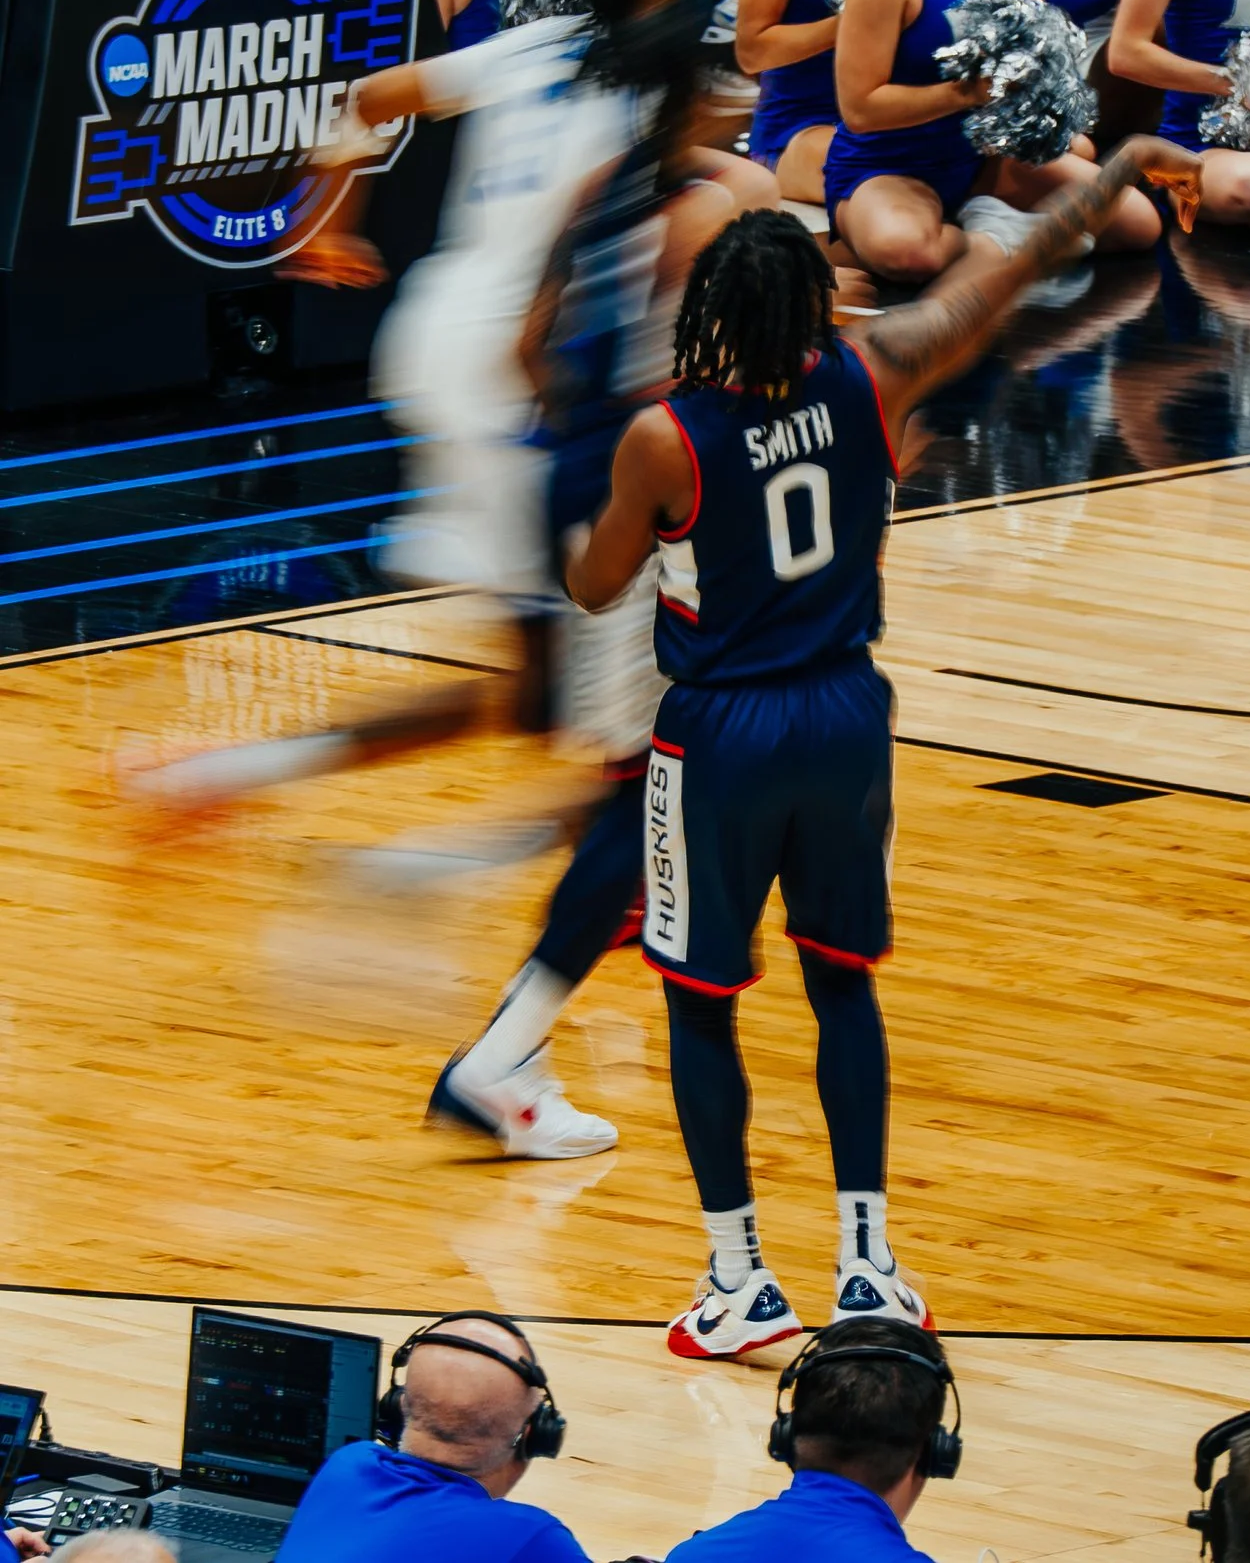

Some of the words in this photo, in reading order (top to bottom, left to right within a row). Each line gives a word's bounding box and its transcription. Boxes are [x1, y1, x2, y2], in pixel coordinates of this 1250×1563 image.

[108, 61, 149, 83] NCAA
[152, 13, 324, 99] MARCH
[173, 80, 405, 167] MADNE
[212, 214, 267, 241] ELITE
[270, 206, 287, 231] 8
[743, 402, 834, 472] SMITH
[764, 462, 835, 582] 0
[651, 763, 676, 942] HUSKIES
